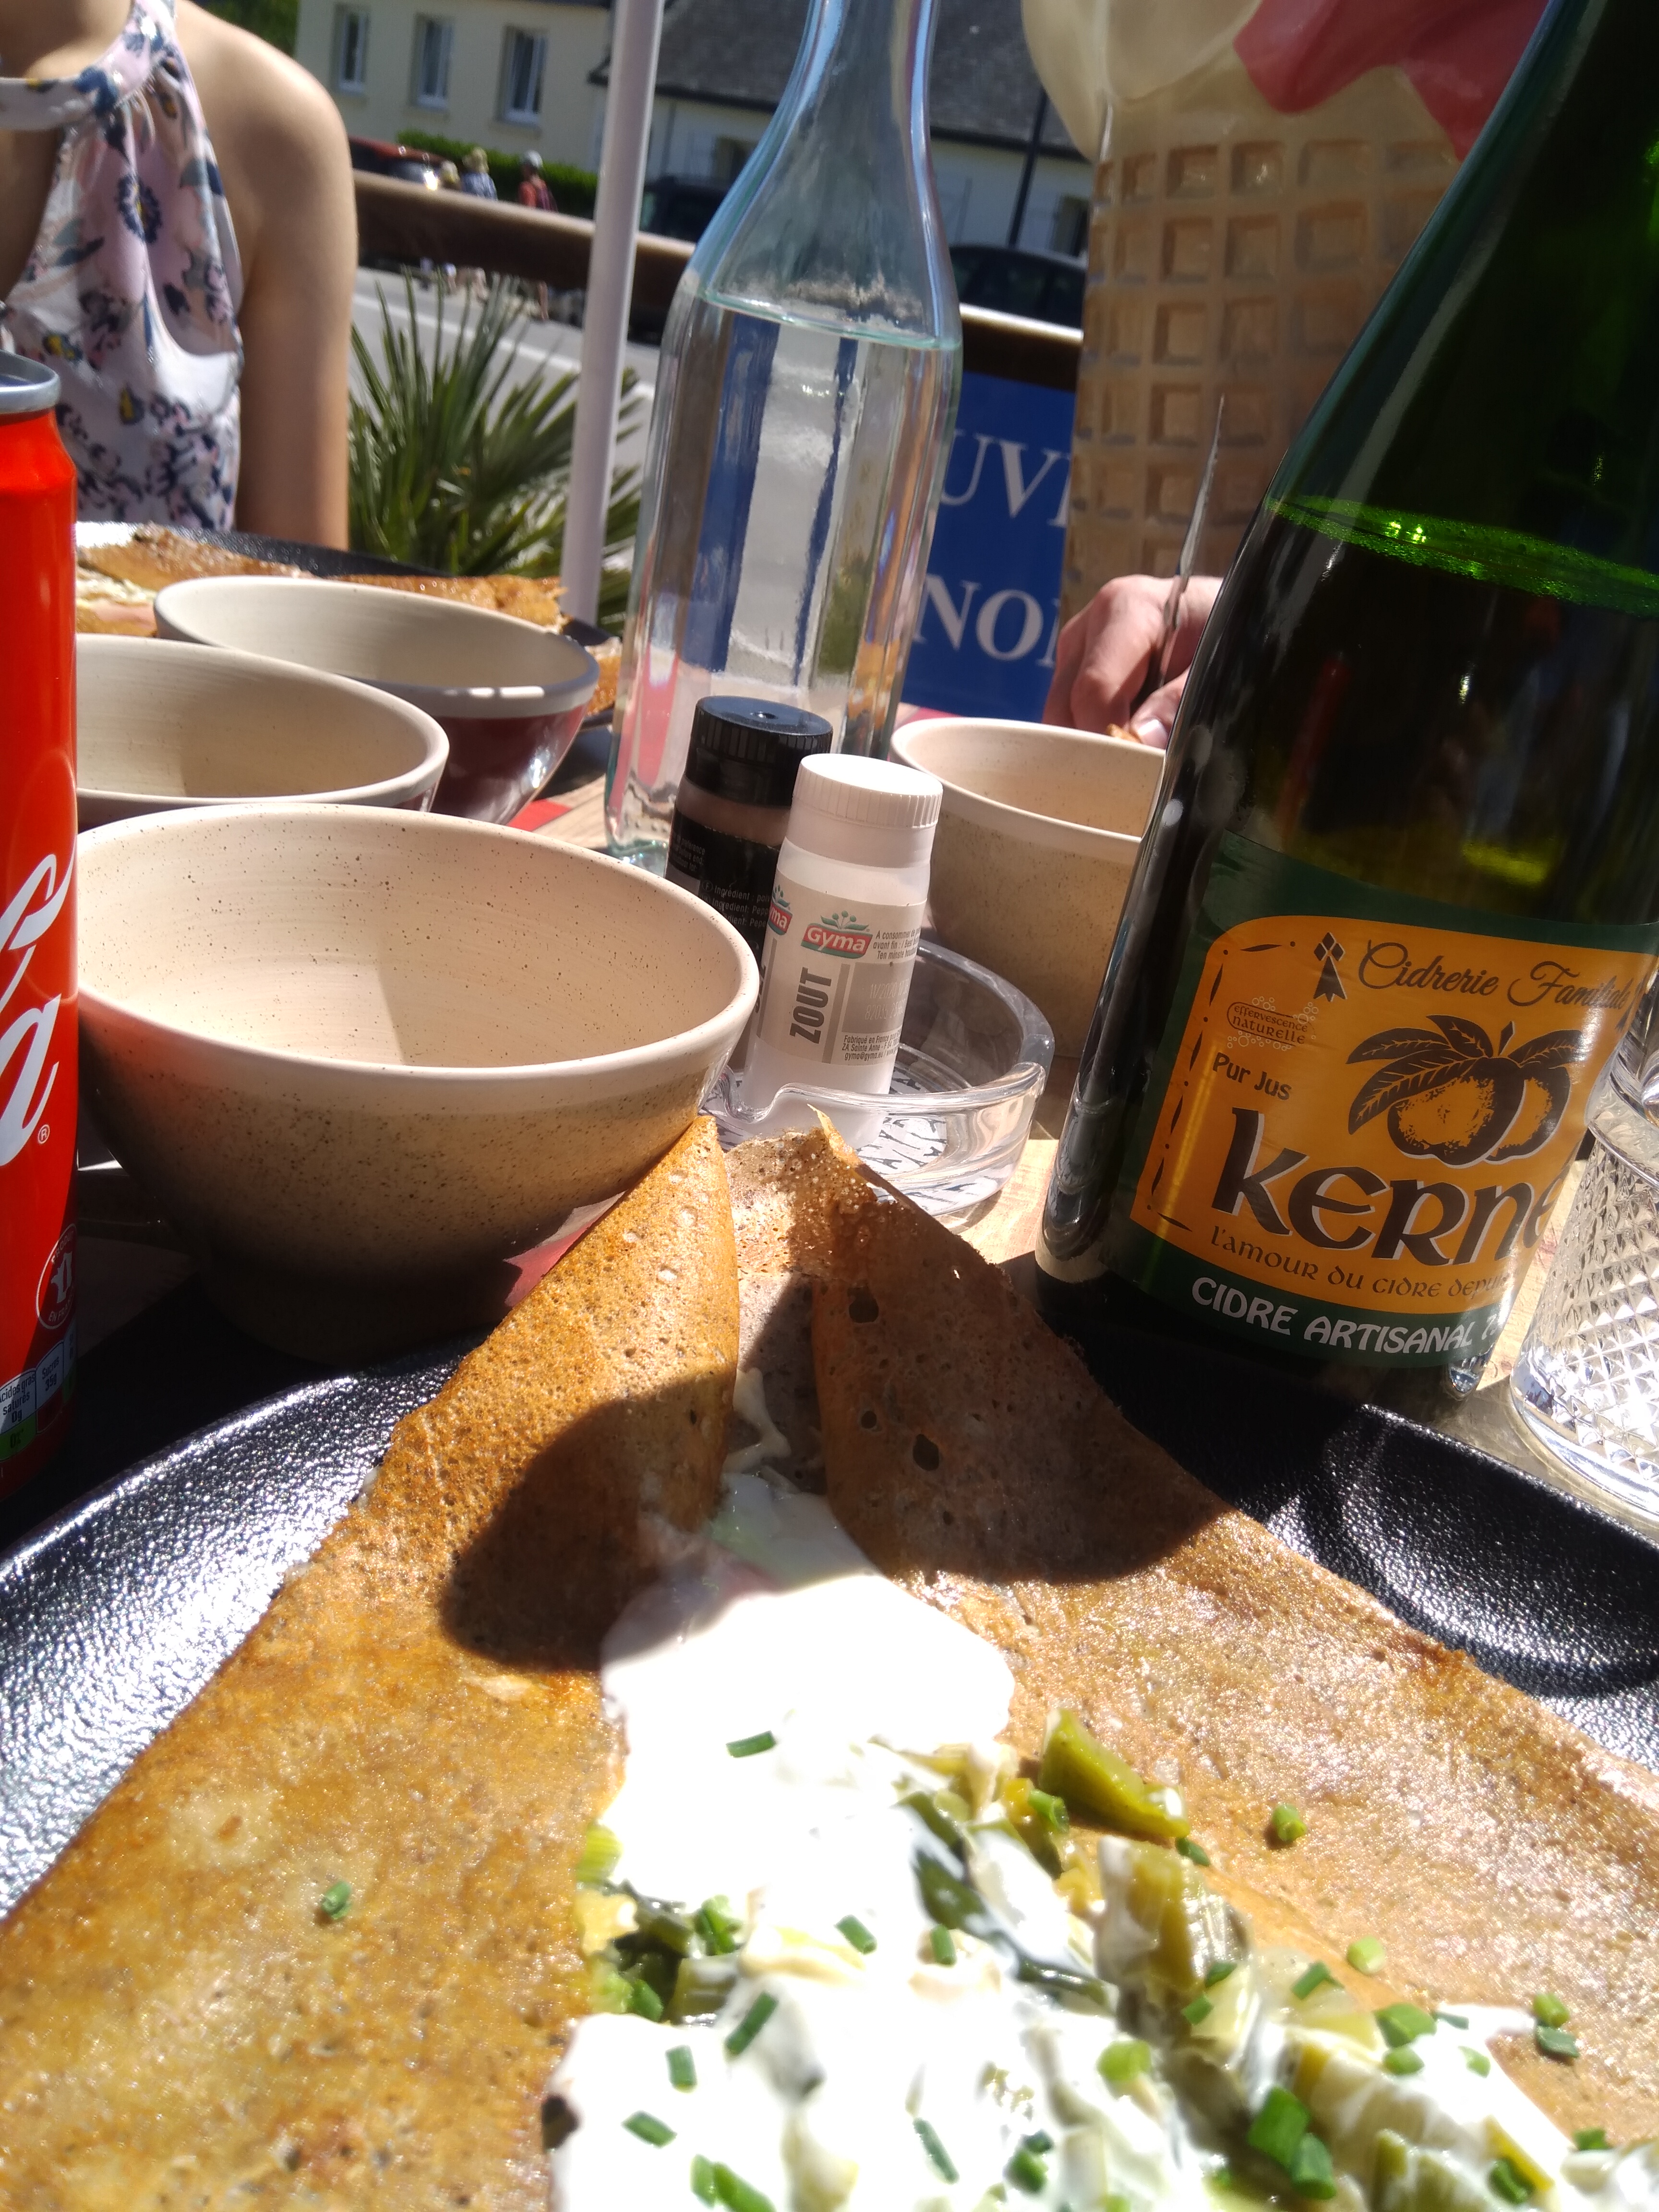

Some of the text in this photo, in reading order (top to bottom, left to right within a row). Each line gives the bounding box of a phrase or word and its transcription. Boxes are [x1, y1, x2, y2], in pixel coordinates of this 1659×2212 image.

[769, 906, 787, 929] ma
[807, 927, 866, 952] Gyma
[873, 941, 890, 950] avant
[882, 930, 911, 940] consommer
[877, 950, 887, 960] Ten
[888, 950, 904, 959] minste
[1358, 939, 1500, 997] Cidrerie
[789, 966, 832, 1045] ZOUT
[842, 1043, 849, 1051] ZA
[851, 1044, 867, 1052] Sainte
[868, 1044, 880, 1052] Anne
[844, 1035, 868, 1045] Fabriqué
[844, 1052, 884, 1062] gyma@gyma.eu
[1213, 1052, 1292, 1100] Pur Jus
[1191, 1276, 1299, 1336] CIDRE
[1303, 1315, 1476, 1354] ARTISANAL
[42, 1357, 60, 1381] Sucres
[21, 1373, 36, 1393] gras
[45, 1373, 58, 1393] 35g
[3, 1392, 30, 1416] saturés
